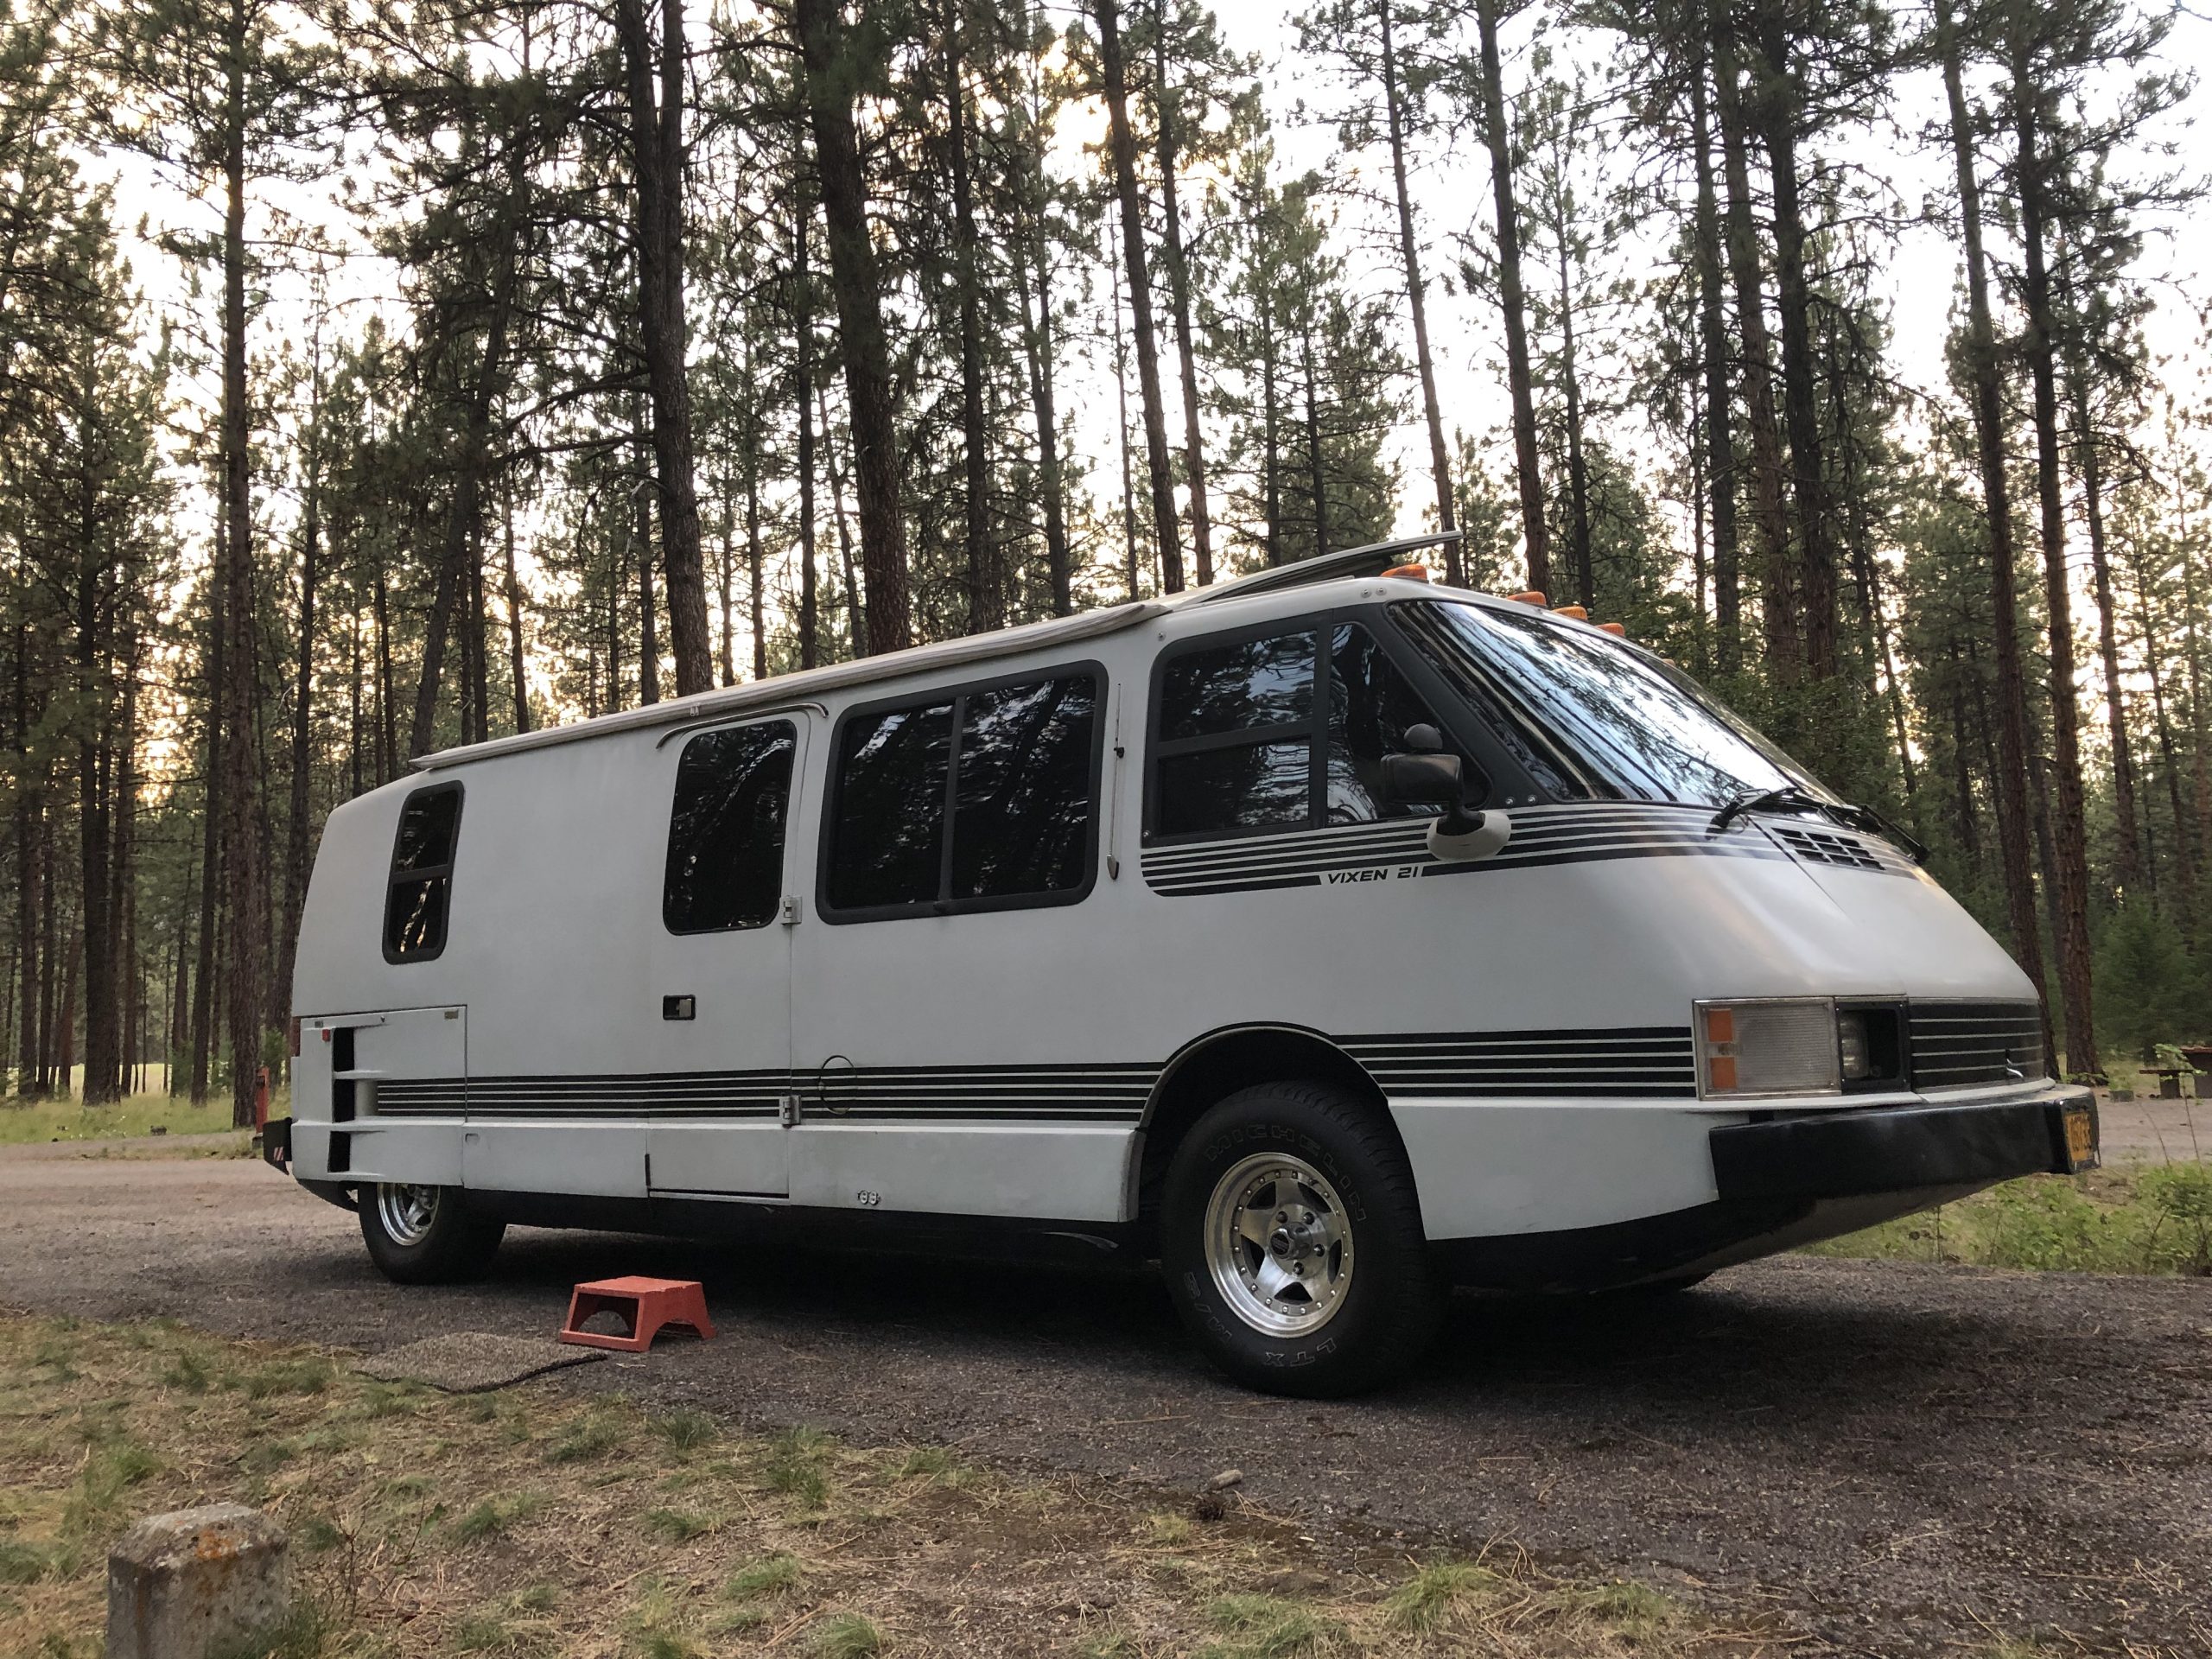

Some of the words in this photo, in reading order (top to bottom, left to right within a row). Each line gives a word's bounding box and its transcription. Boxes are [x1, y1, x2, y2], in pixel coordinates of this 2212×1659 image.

[1328, 868, 1388, 884] VIXEN
[1397, 867, 1418, 879] 21
[1205, 1124, 1367, 1221] MICHELIN
[1264, 1337, 1338, 1367] LTX
